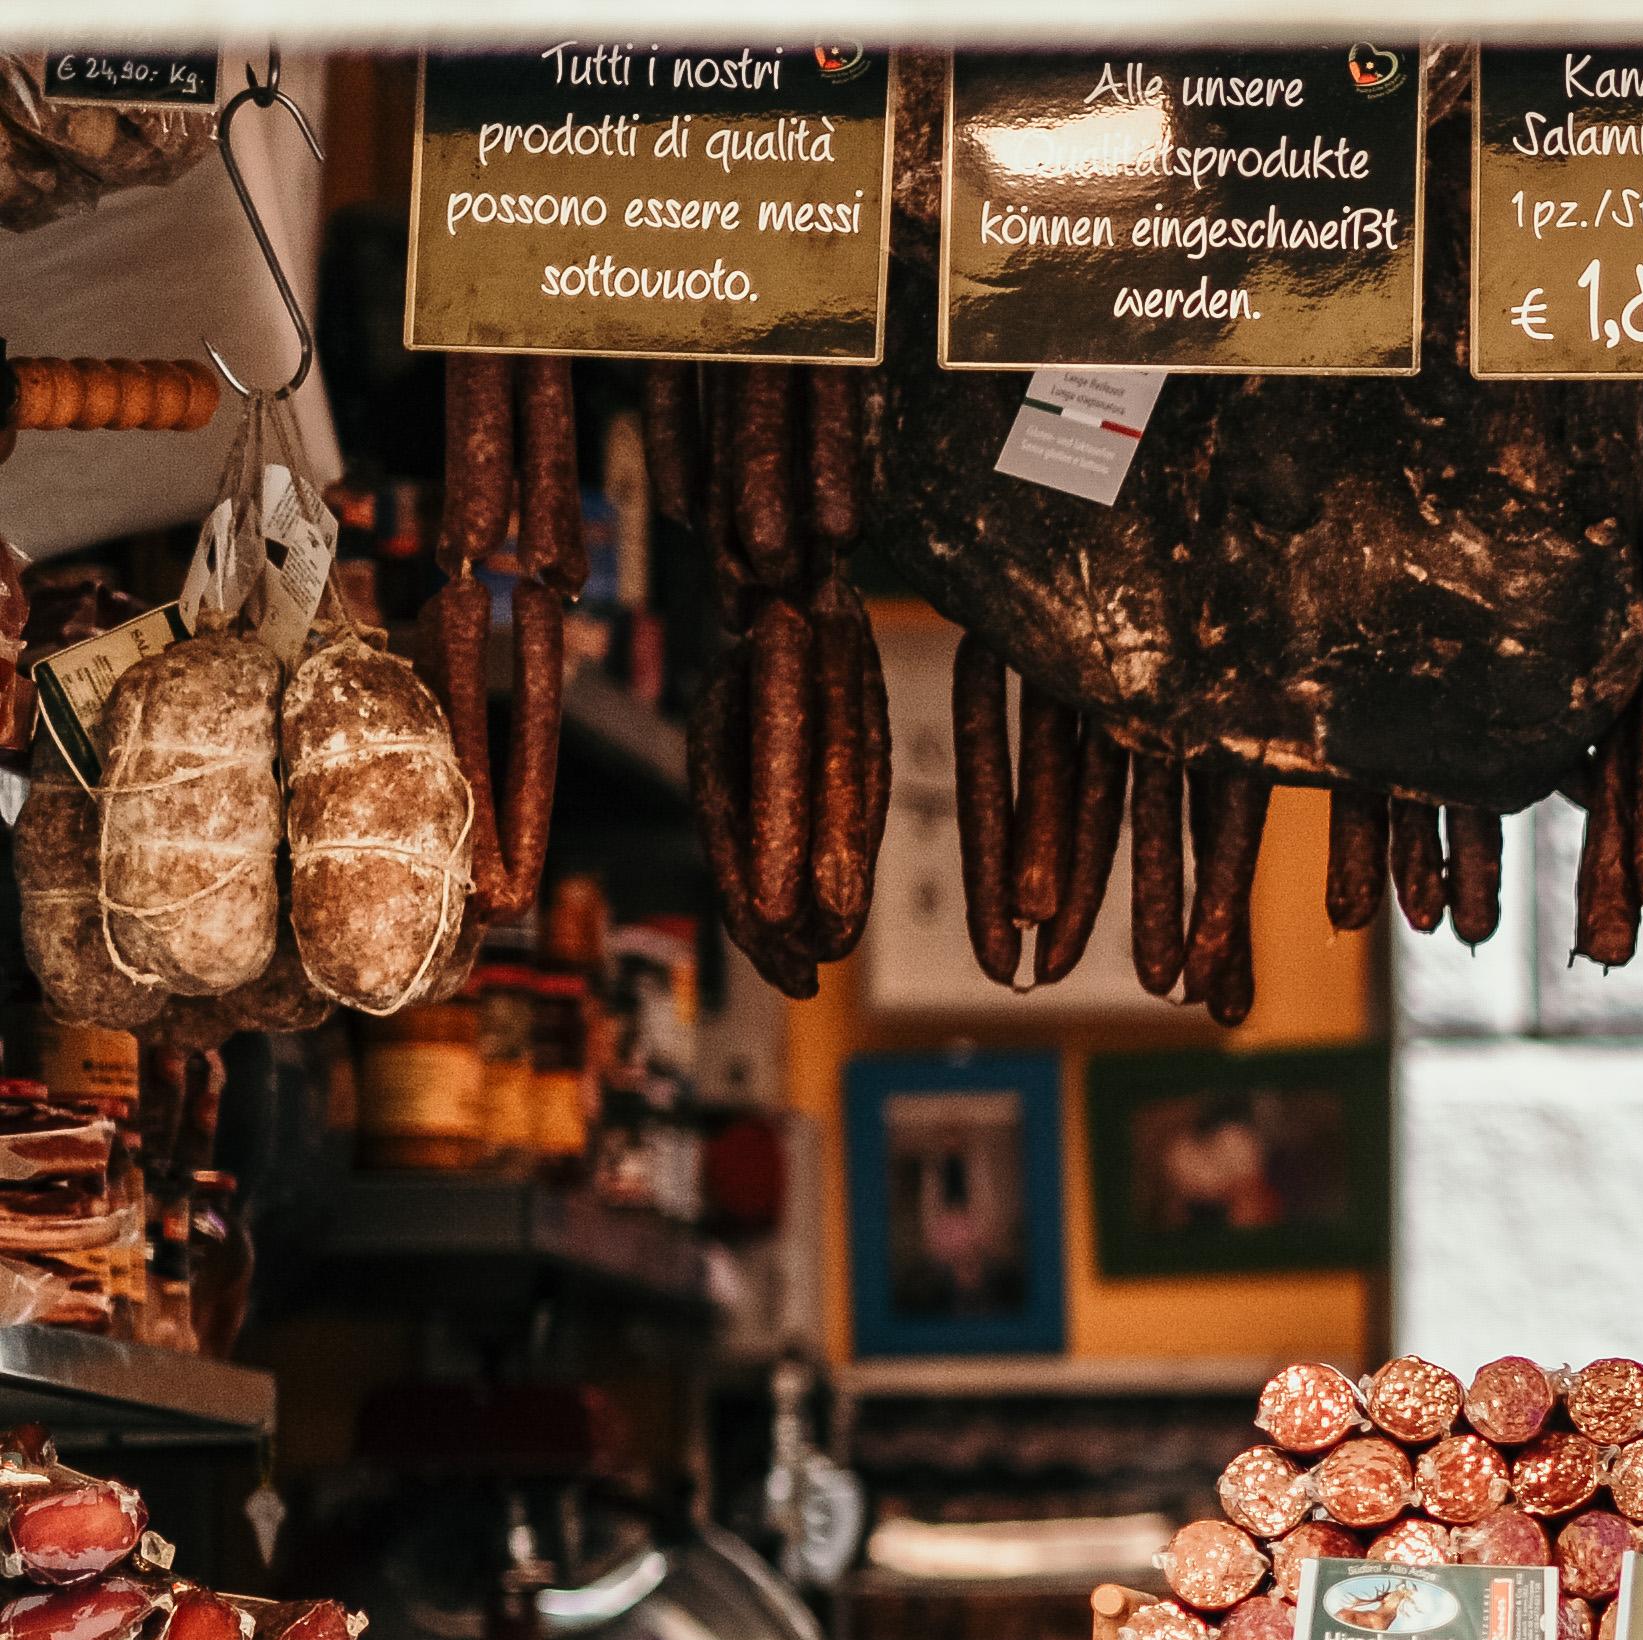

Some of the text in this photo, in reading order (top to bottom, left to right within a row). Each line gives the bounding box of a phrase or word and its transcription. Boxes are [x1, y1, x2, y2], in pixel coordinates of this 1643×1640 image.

[542, 41, 783, 91] Tutti i nostri
[1084, 62, 1304, 108] Alle unsere
[478, 113, 838, 173] prodotti di qualità
[447, 188, 865, 236] possono essere messi
[980, 201, 1399, 260] können eingeschweißt
[540, 256, 760, 304] sottovuoto.
[1114, 276, 1262, 320] werden.
[1510, 288, 1555, 340] €
